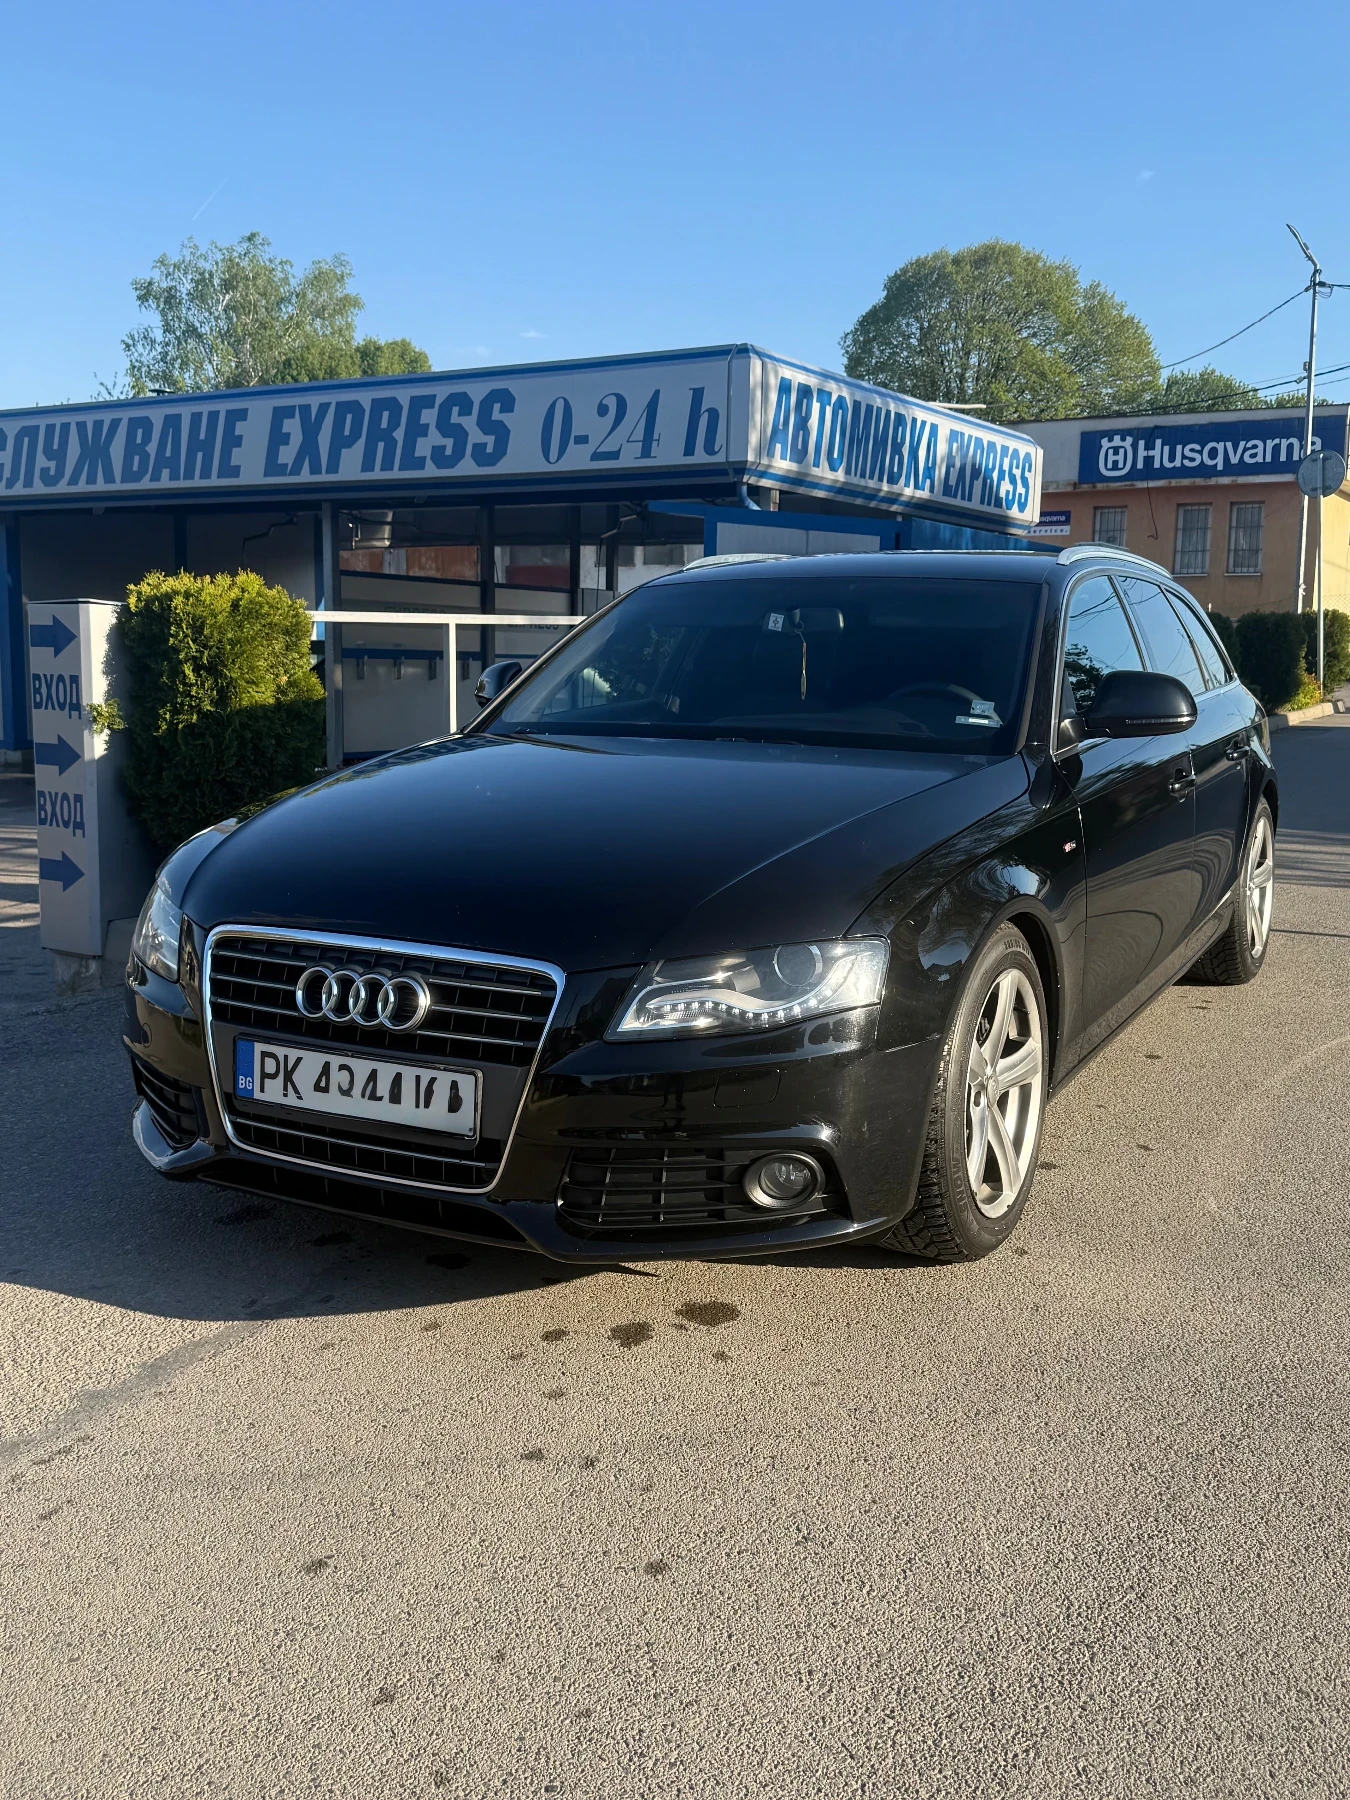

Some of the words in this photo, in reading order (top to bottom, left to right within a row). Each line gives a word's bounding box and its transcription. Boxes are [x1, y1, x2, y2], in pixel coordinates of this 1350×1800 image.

[263, 387, 517, 478] EXPRESS
[541, 389, 661, 465] 0-24
[683, 386, 723, 457] h
[766, 376, 939, 495] АВТОМИВКА
[942, 428, 1033, 514] EXPRESS
[32, 673, 82, 720] ВХОД
[37, 789, 86, 838] ВХОД
[238, 1076, 253, 1090] BG
